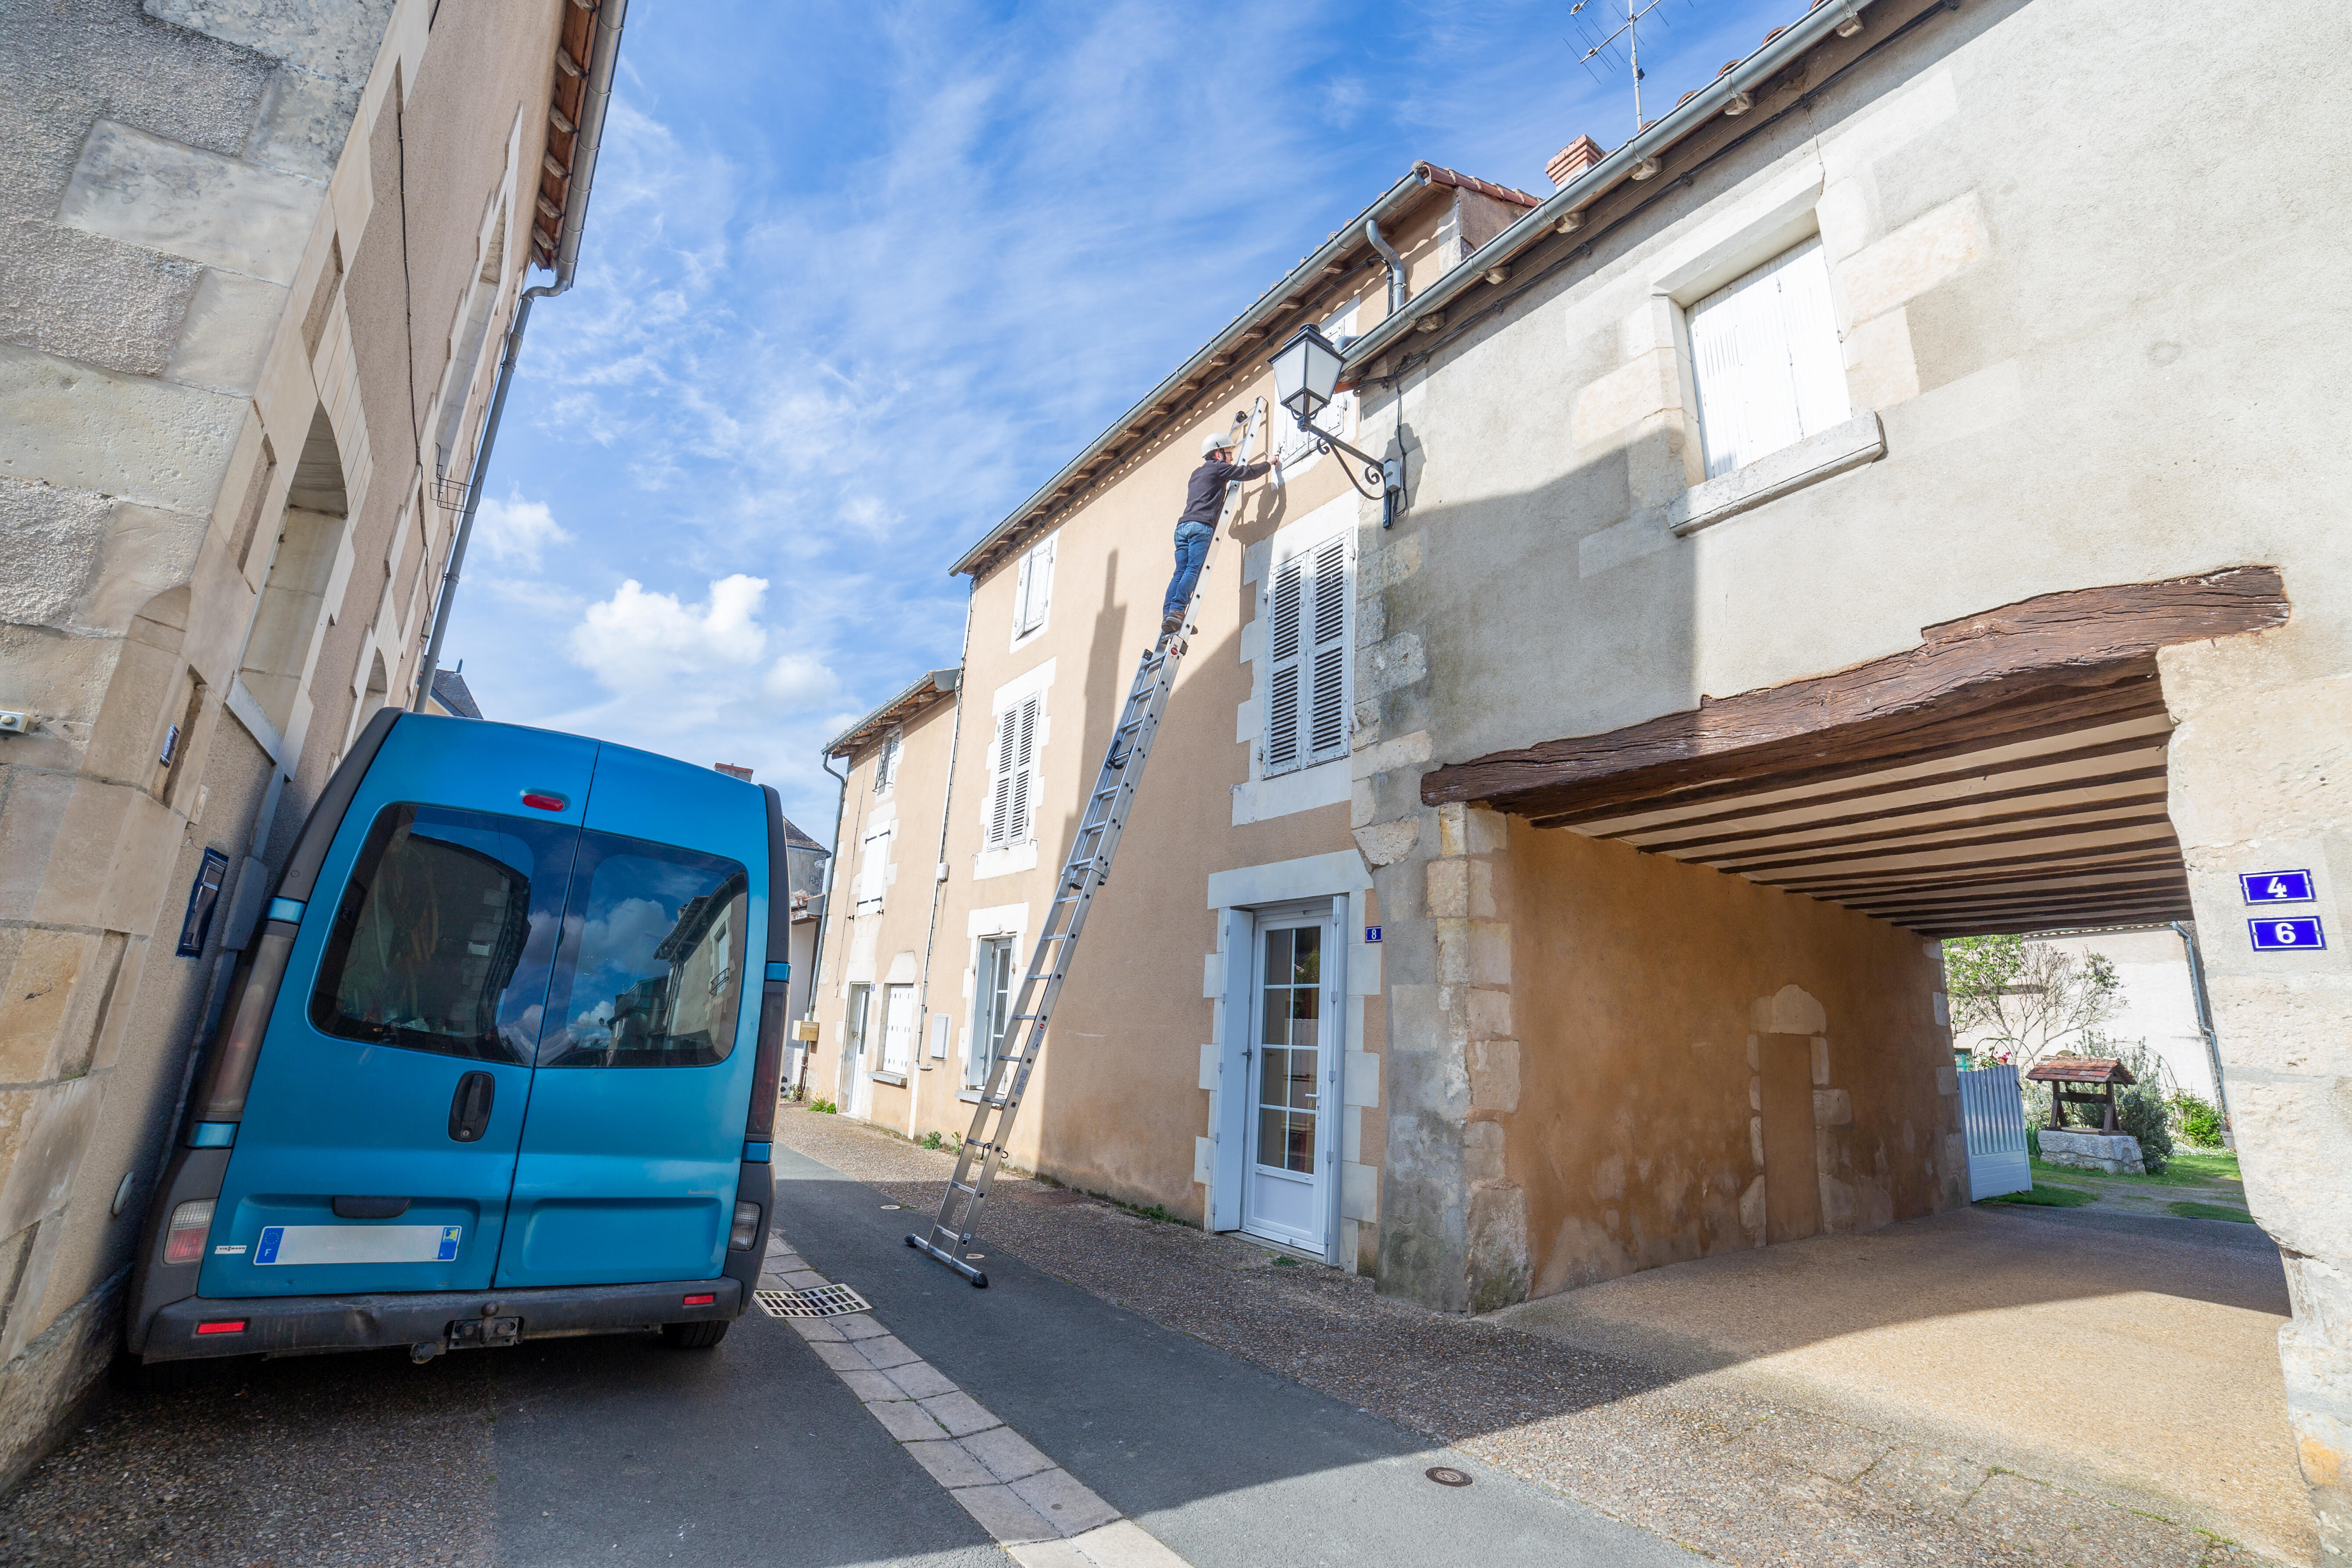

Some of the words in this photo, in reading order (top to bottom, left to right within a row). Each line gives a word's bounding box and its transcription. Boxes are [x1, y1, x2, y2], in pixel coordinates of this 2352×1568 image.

[2267, 877, 2287, 897] 4
[1372, 929, 1376, 939] 8
[2275, 922, 2296, 944] 6
